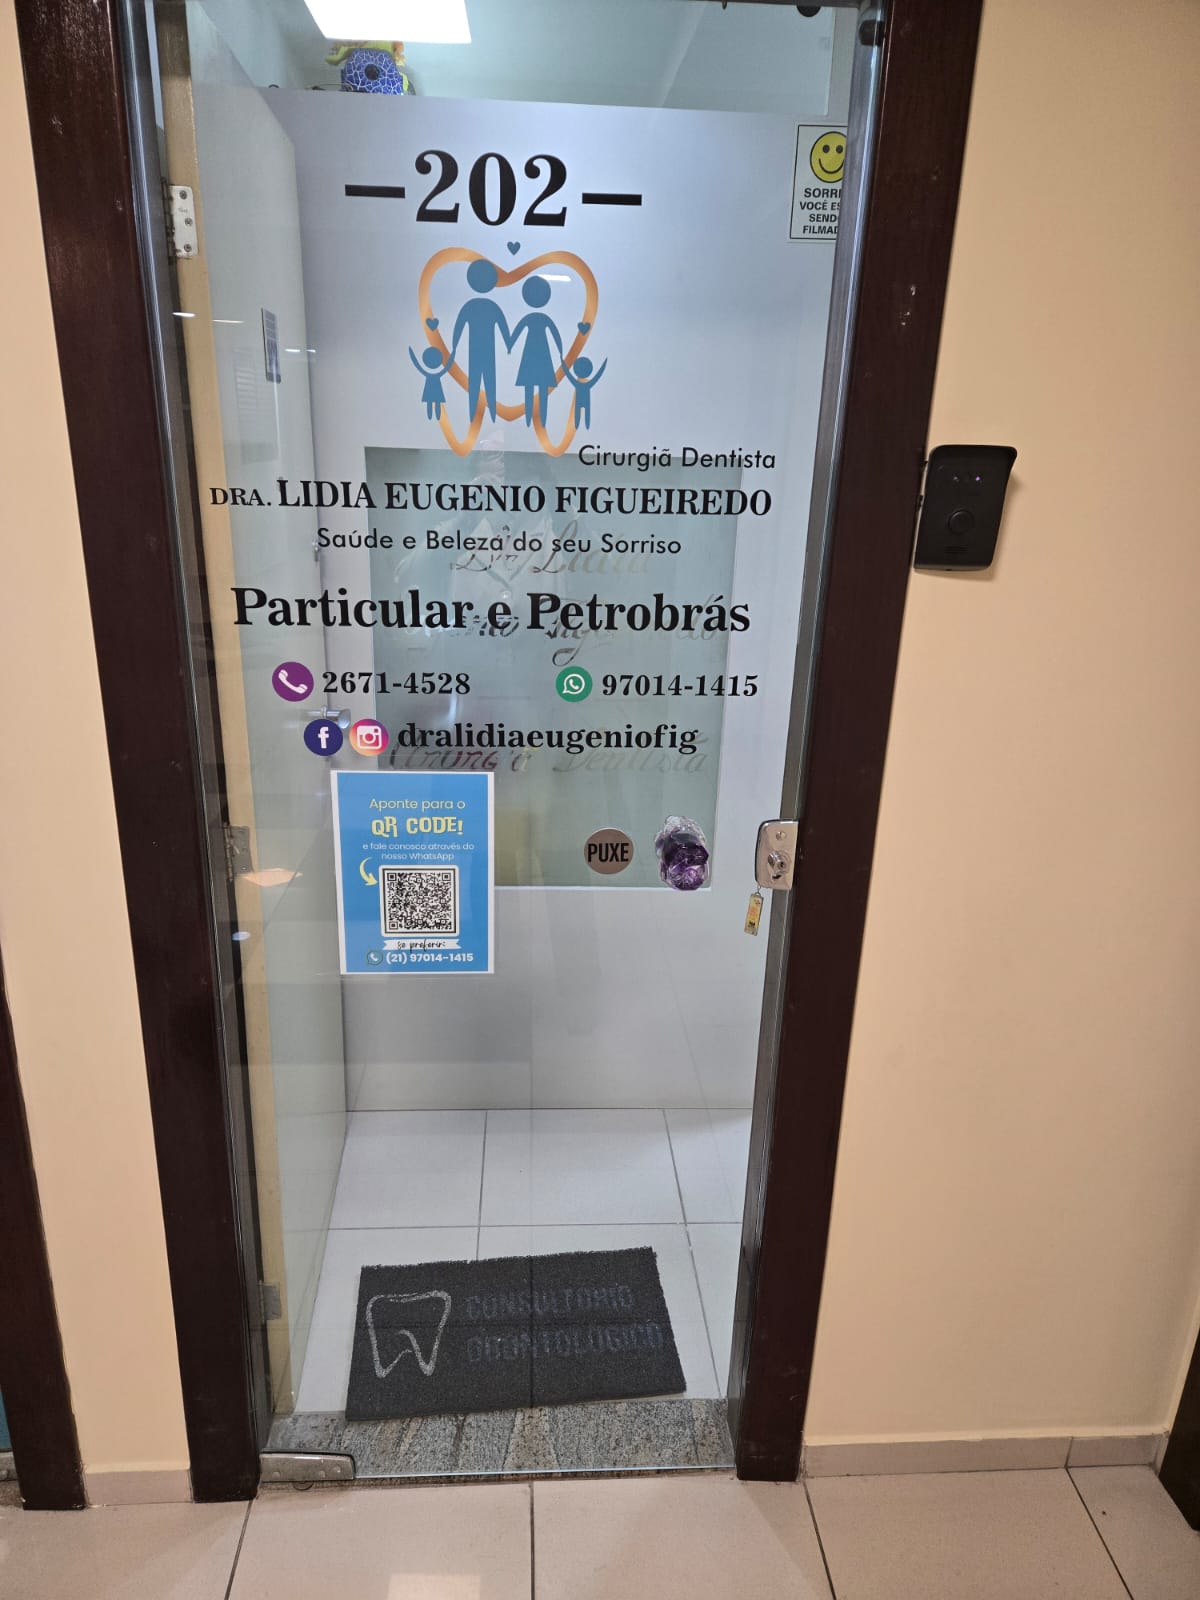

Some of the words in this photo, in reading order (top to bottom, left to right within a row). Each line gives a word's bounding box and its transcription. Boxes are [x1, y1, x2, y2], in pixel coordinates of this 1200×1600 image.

[803, 187, 842, 199] SORRI
[800, 200, 828, 211] VOCÊ
[809, 213, 840, 223] SEND
[802, 225, 839, 235] FILMAD
[578, 445, 672, 472] Cirurgiã
[681, 447, 776, 469] Dentista
[209, 487, 272, 506] DRA.
[276, 479, 376, 508] LIDIA
[384, 482, 546, 512] EUGENIO
[554, 486, 773, 516] FIGUEIREDO
[317, 527, 393, 549] Saúde
[403, 536, 416, 549] e
[426, 530, 503, 552] Beleza
[513, 531, 542, 552] do
[551, 538, 591, 553] seu
[600, 534, 682, 555] Sorriso
[230, 586, 473, 629] Particular
[487, 600, 512, 628] e
[526, 592, 750, 633] Petrobrás
[322, 671, 471, 694] 2671-4528
[602, 674, 758, 697] 97014-1415
[397, 722, 699, 755] dralidiaeugeniofig
[369, 799, 418, 812] Aponte
[421, 800, 453, 812] para
[456, 800, 466, 809] o
[371, 816, 398, 838] QR
[406, 816, 463, 835] CODE!
[370, 842, 387, 850] fale
[428, 842, 460, 850] através
[587, 843, 630, 863] PUXE
[410, 852, 454, 862] WhatsApp
[386, 952, 408, 964] (21)
[410, 953, 474, 963] 97014-1415
